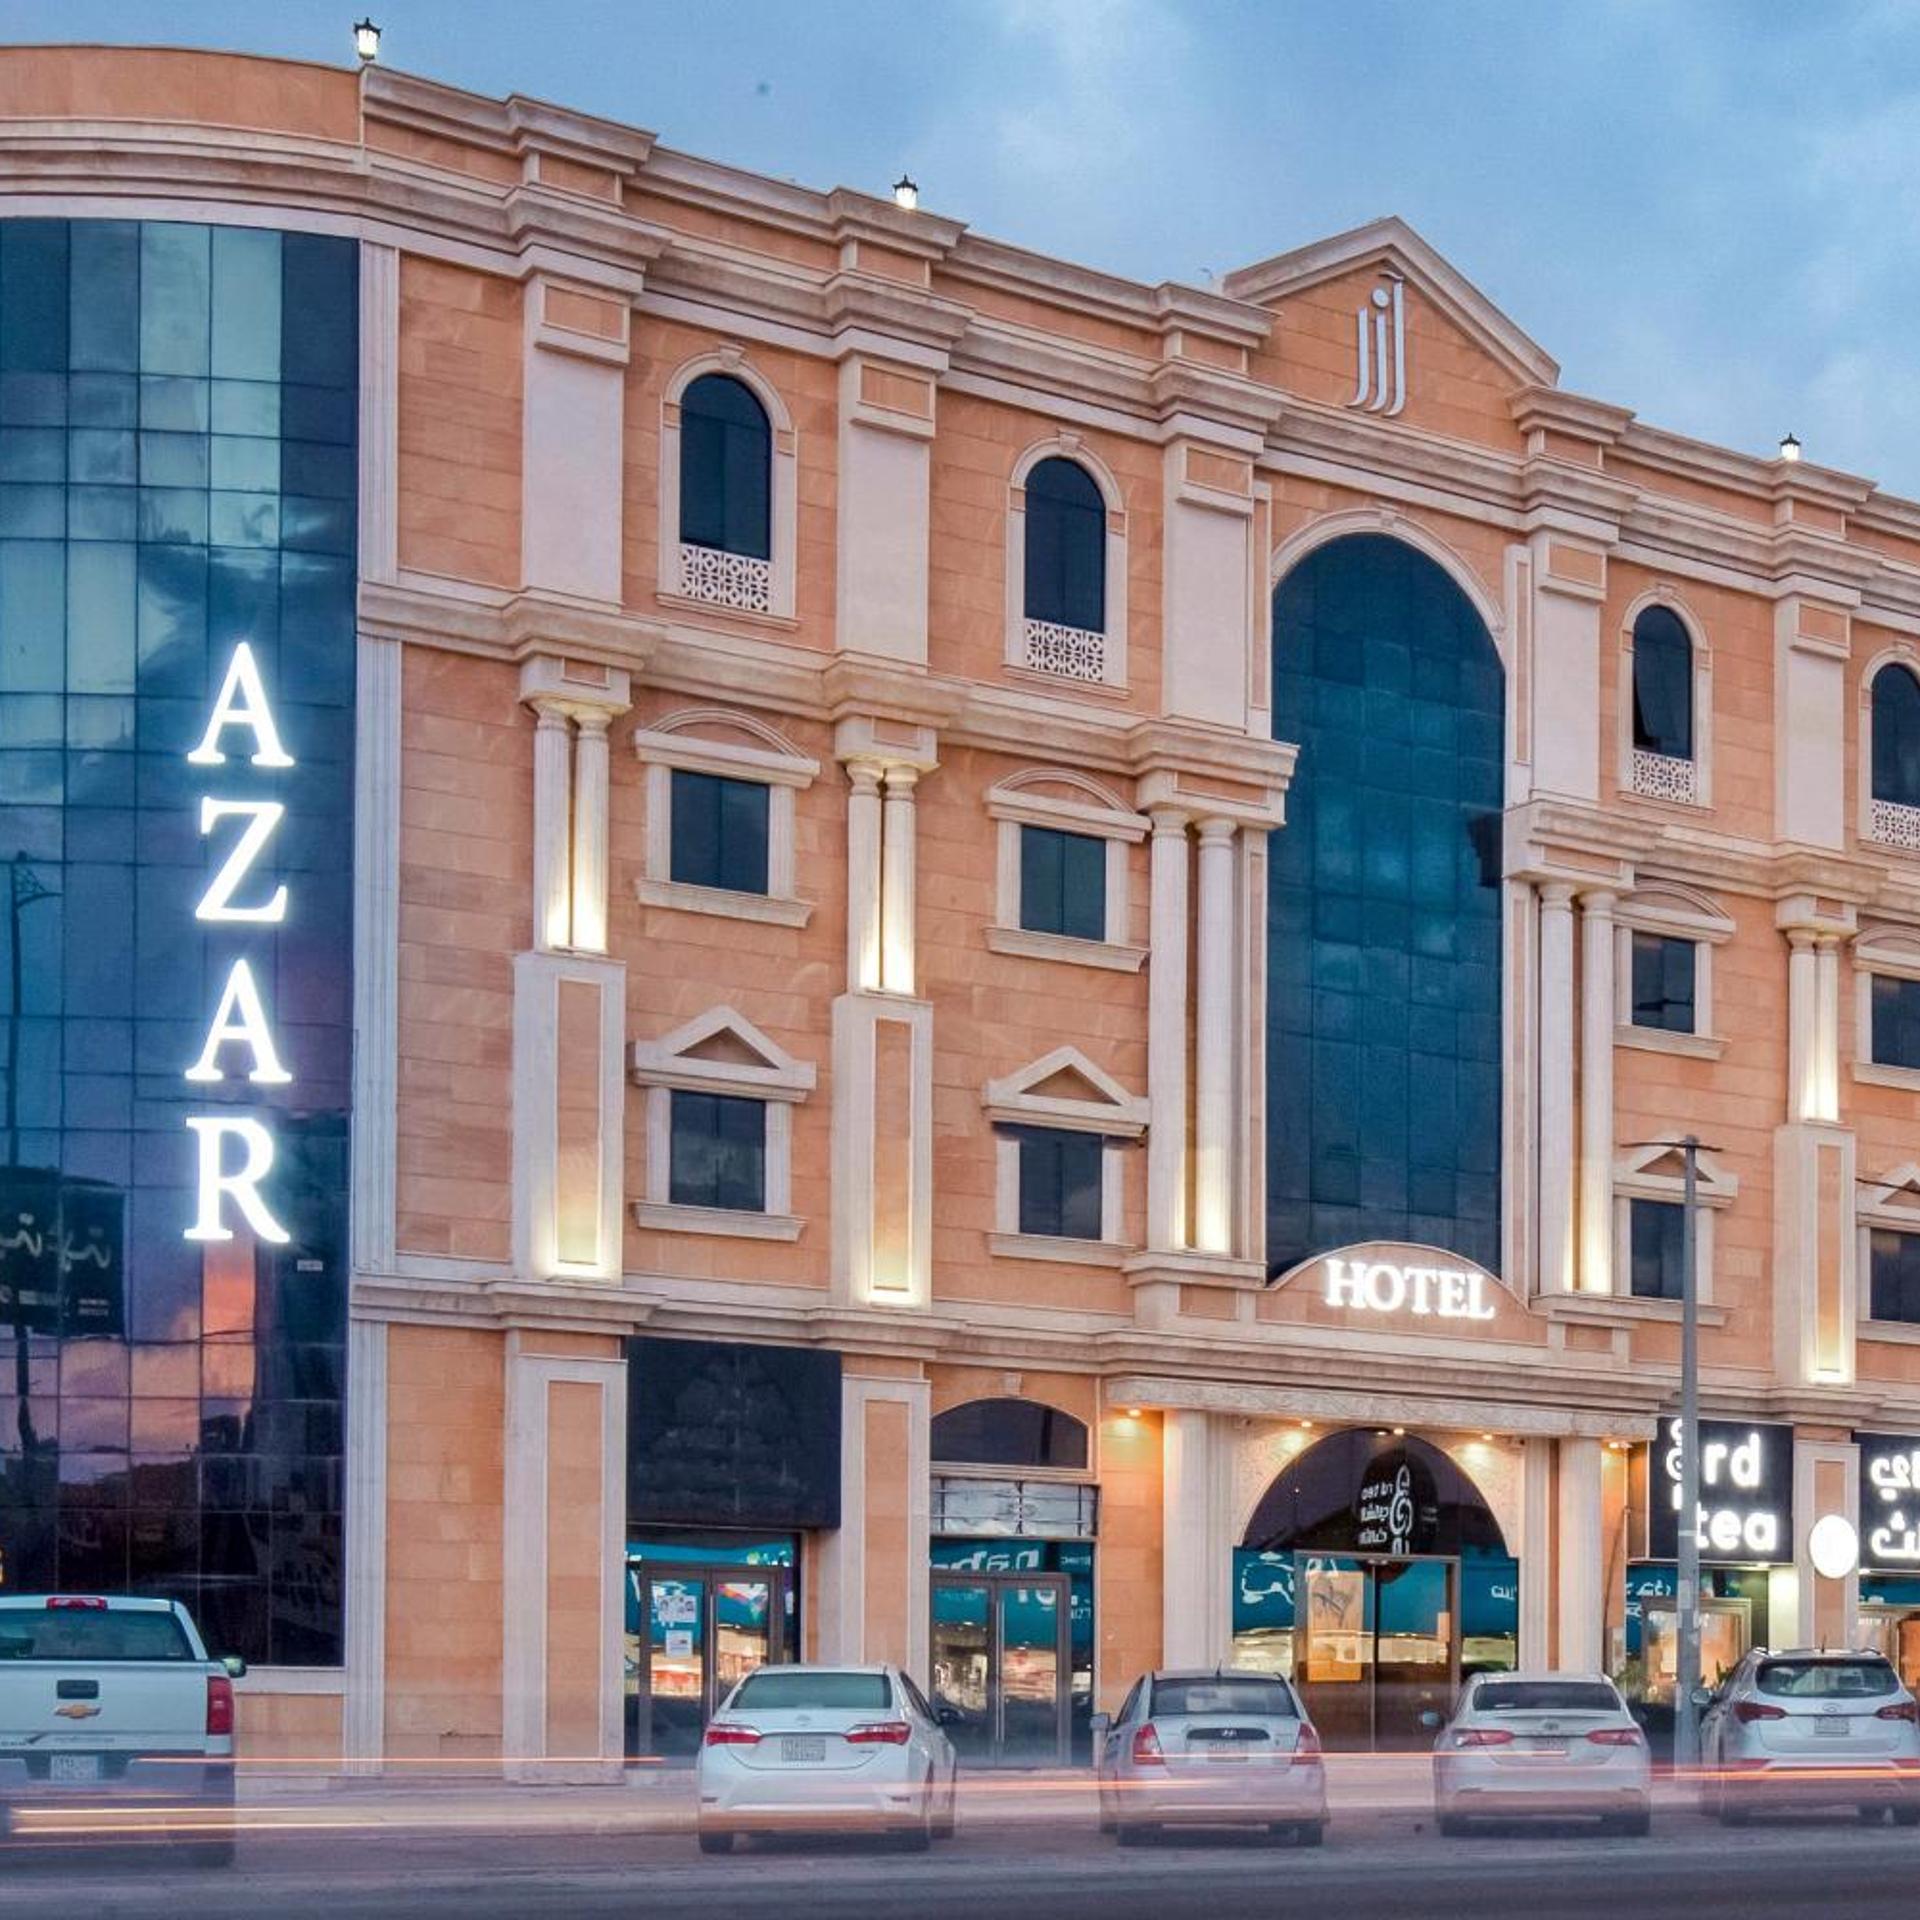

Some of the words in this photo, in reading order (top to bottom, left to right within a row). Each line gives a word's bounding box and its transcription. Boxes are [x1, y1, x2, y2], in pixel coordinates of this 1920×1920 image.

[184, 641, 294, 1244] AZAR
[1325, 1259, 1495, 1320] HOTEL
[1695, 1501, 1778, 1552] tea
